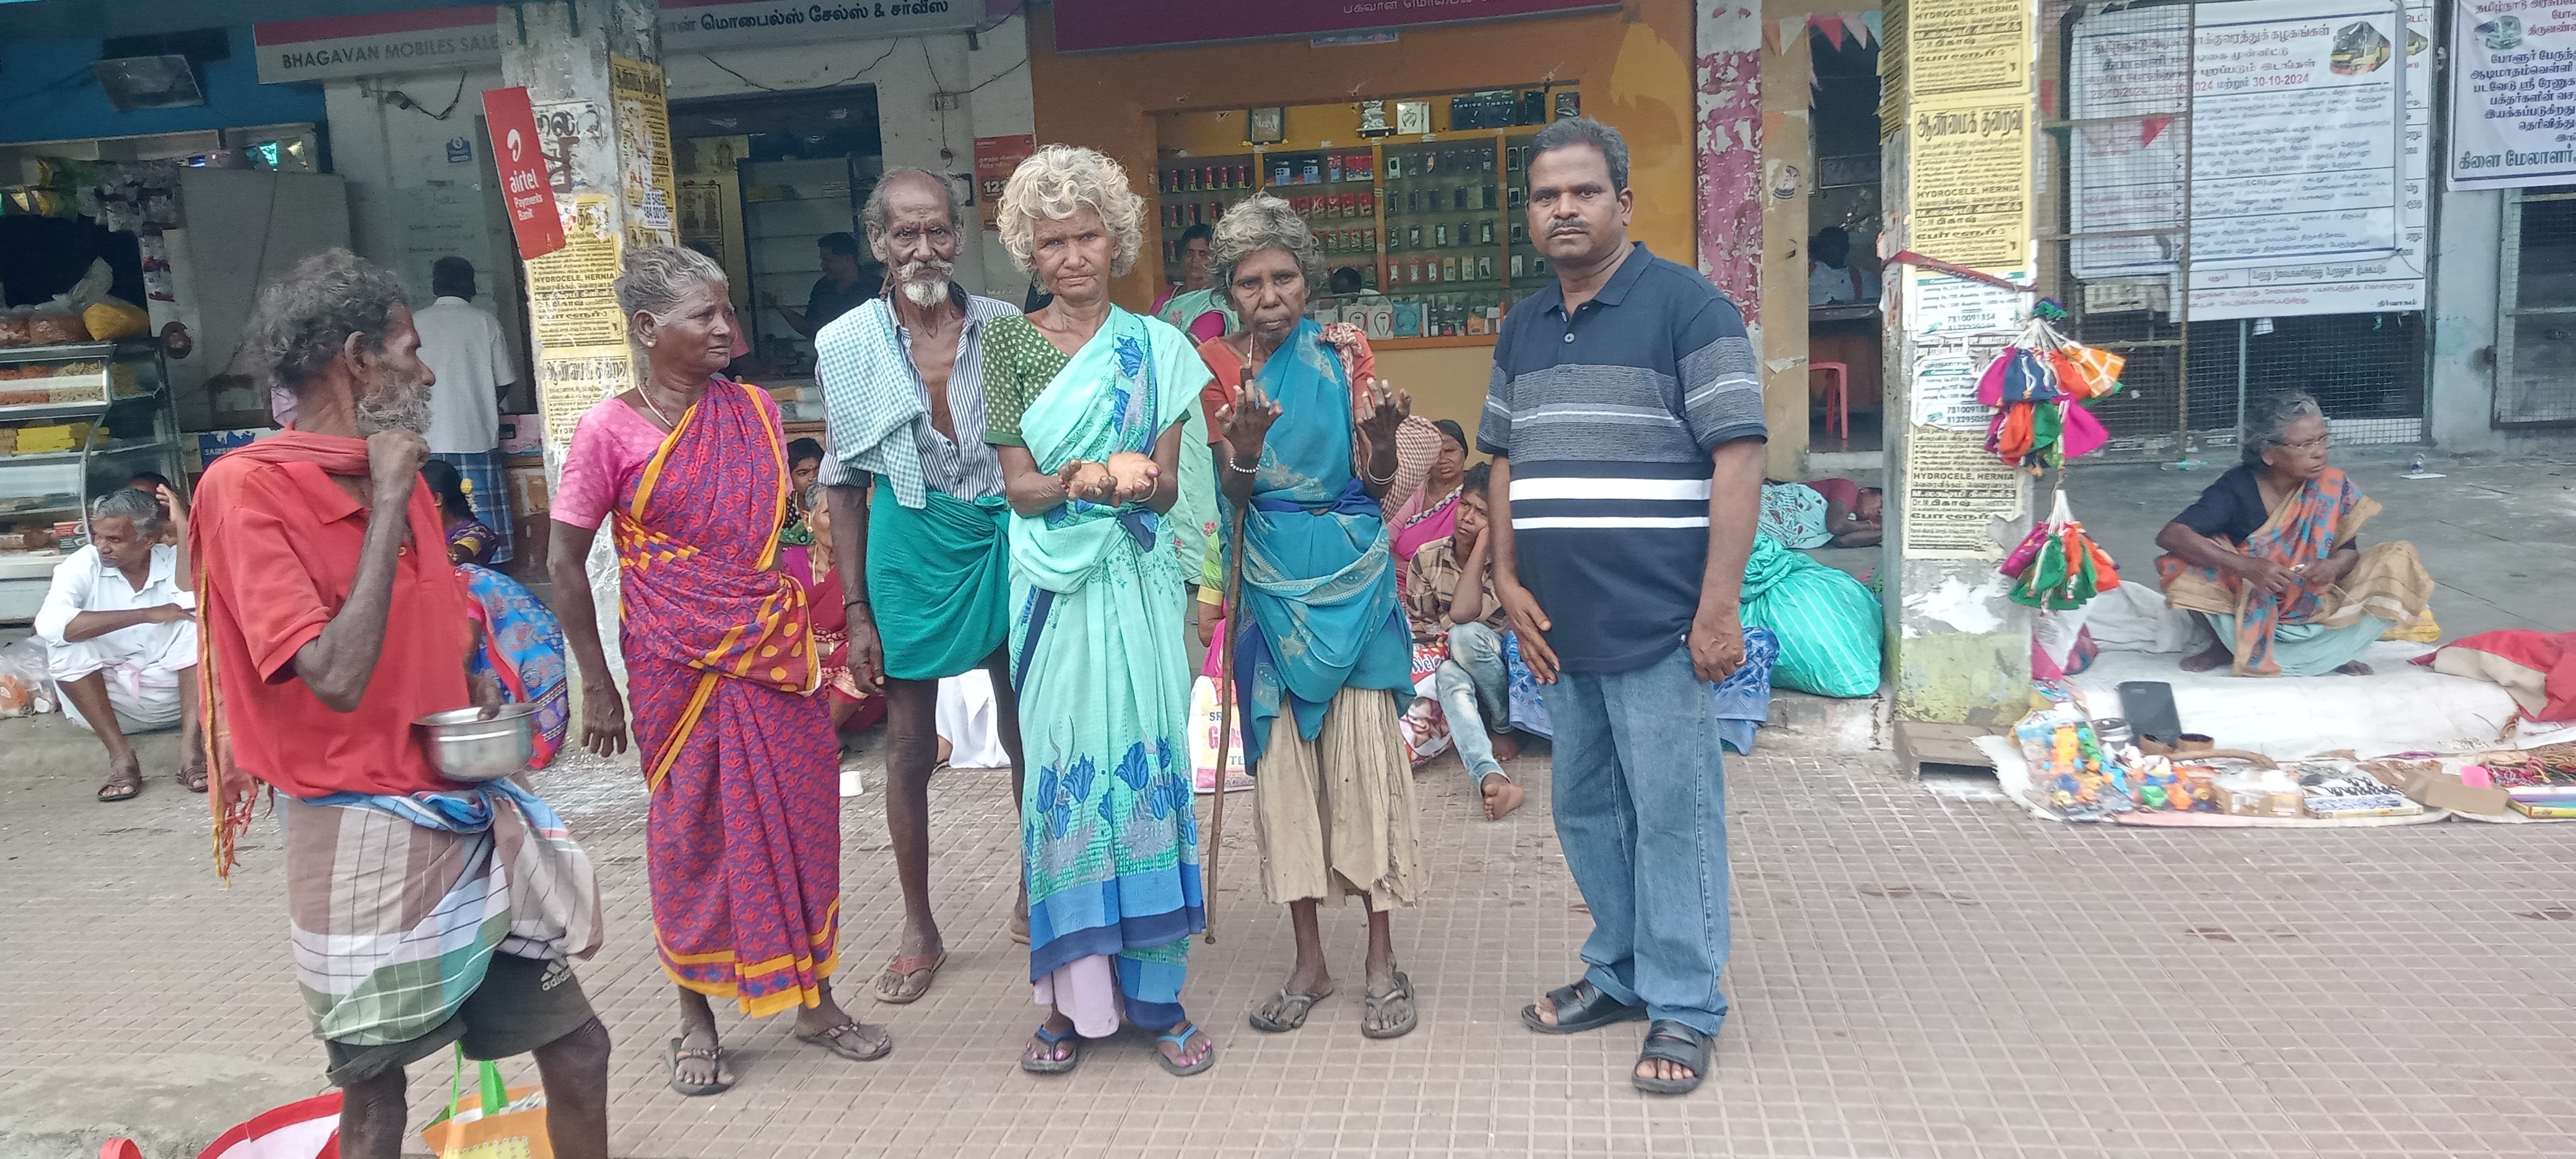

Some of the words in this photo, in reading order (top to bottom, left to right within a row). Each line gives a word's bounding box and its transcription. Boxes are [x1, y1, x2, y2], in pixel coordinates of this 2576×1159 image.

[701, 8, 804, 30] மொபைல்ஸ்
[809, 2, 868, 22] சேல்ஸ்
[874, 2, 886, 17] &
[1982, 4, 2019, 14] HERNIA
[2272, 24, 2330, 42] கழகங்கள்
[282, 46, 380, 70] BHAGAVAN
[385, 38, 455, 60] MOBILES
[2232, 47, 2289, 61] முன்னிட்டு
[2491, 50, 2536, 64] போளூர்
[2201, 63, 2256, 77] புறப்படும்
[2217, 77, 2250, 90] மற்றும்
[2253, 73, 2310, 87] 30-10-2024
[2490, 90, 2554, 106] பக்தர்களின்
[2484, 104, 2576, 119] இயக்கப்படுகிறது
[1982, 108, 2023, 137] குறைவு
[2459, 151, 2501, 170] கிளை
[508, 168, 540, 194] airtel
[1917, 188, 1979, 199] HYDROCELE,
[1982, 184, 2020, 193] HERNIA
[513, 193, 544, 214] Payments
[517, 209, 535, 222] Bank
[534, 275, 583, 283] HYDROCELE,
[585, 272, 615, 280] HERNIA
[204, 446, 234, 456] SAMS
[1913, 472, 1975, 480] HYDROCELE,
[1209, 711, 1222, 721] SR
[1229, 756, 1245, 765] TE
